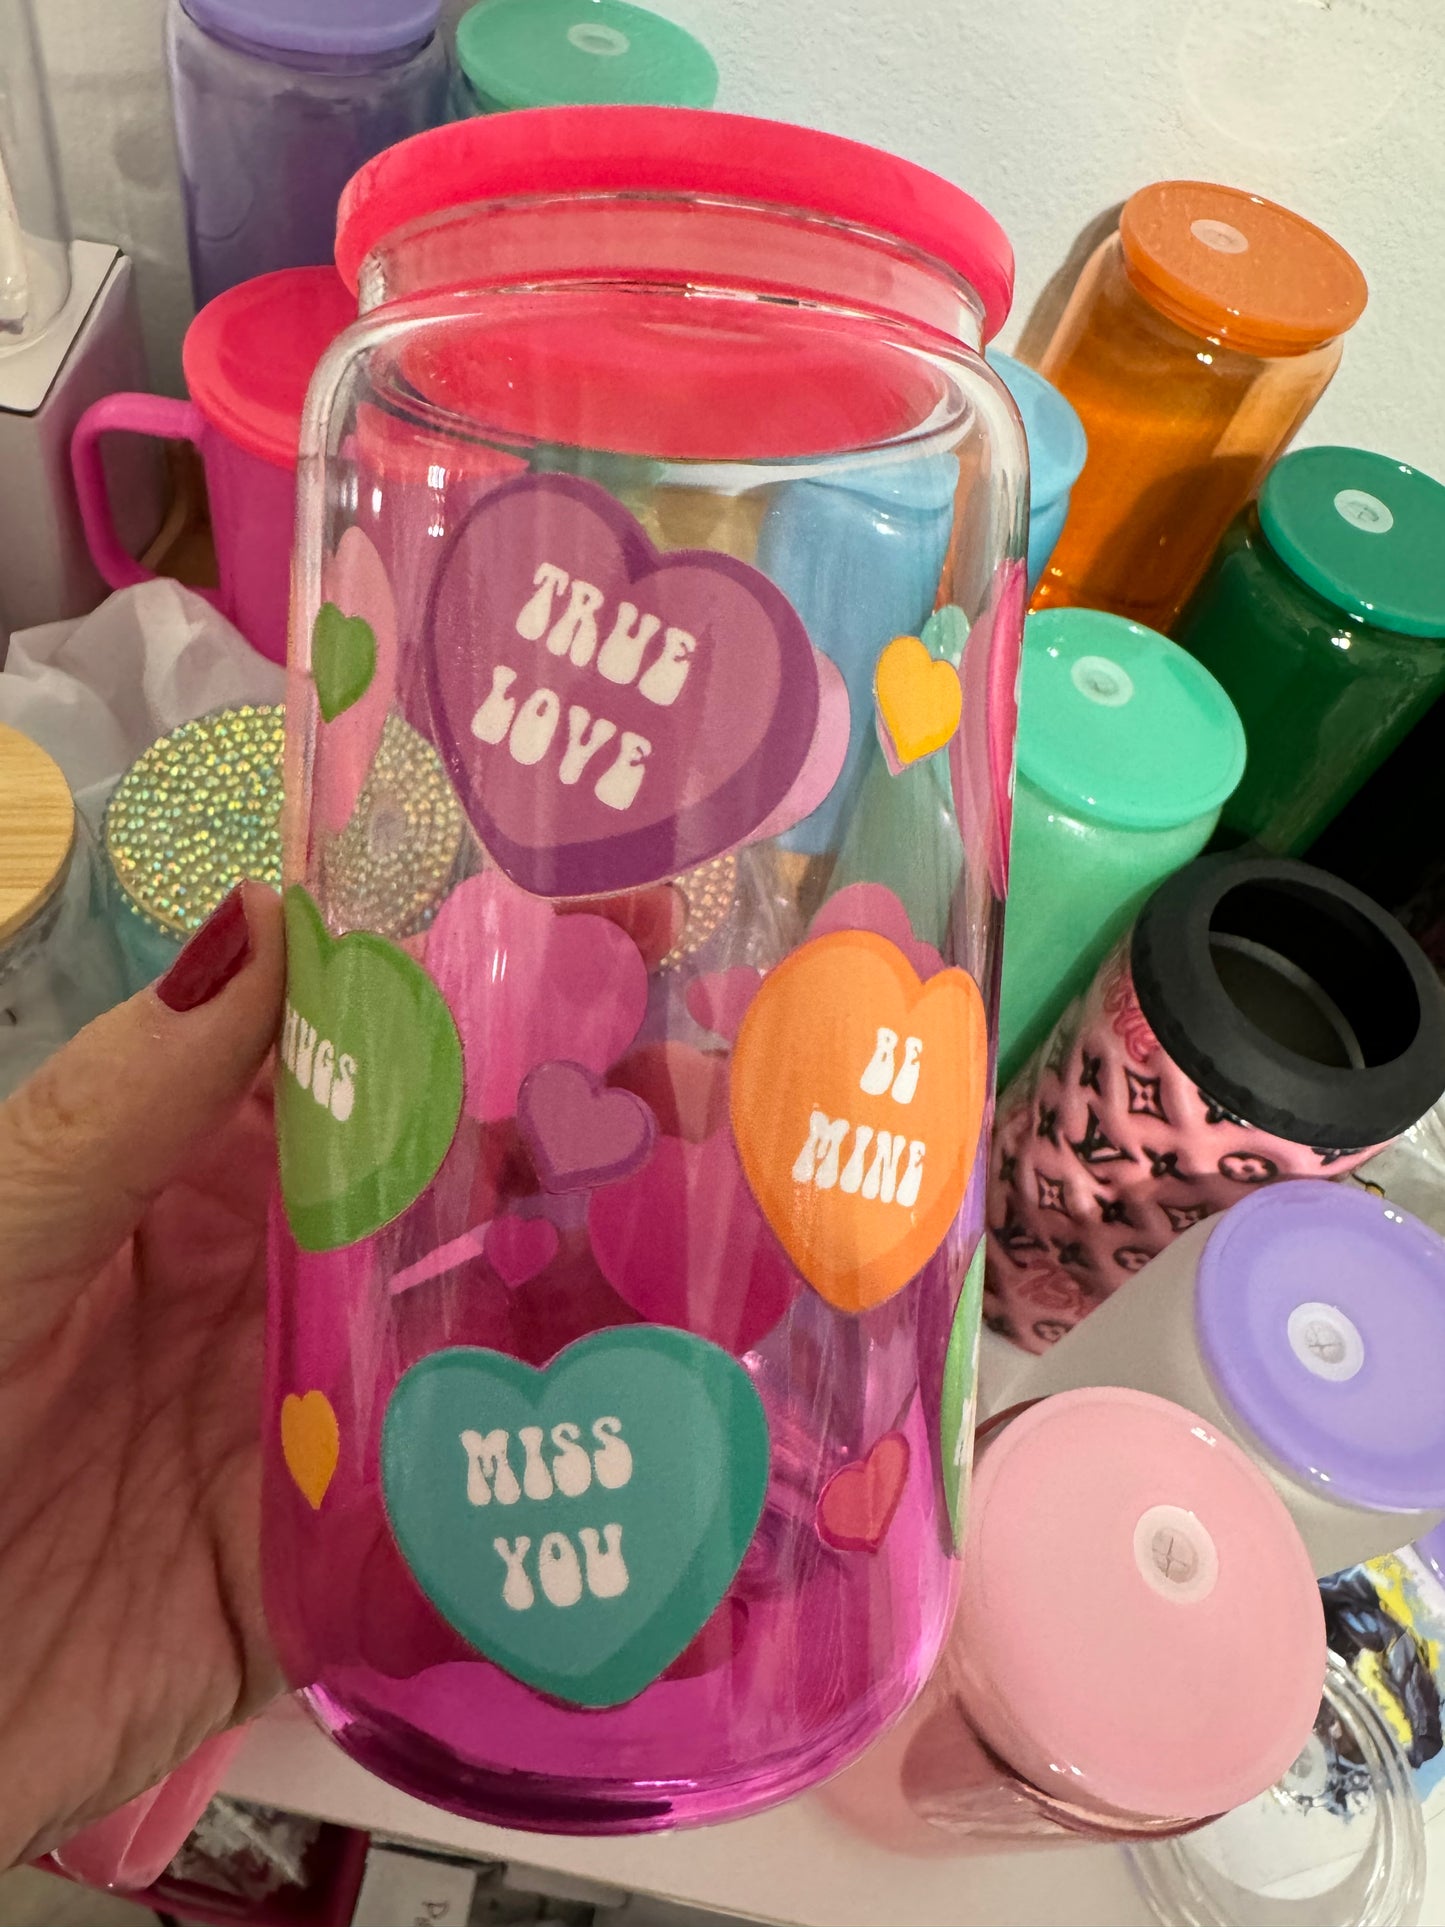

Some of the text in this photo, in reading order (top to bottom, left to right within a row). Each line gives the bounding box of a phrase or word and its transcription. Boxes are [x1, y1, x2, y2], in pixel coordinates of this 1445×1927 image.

[515, 562, 697, 706] TRUE
[470, 665, 652, 810] LOVE
[859, 1026, 923, 1105] BE
[791, 1110, 926, 1207] MINE
[459, 1415, 633, 1507] MISS
[493, 1523, 630, 1611] YOU
